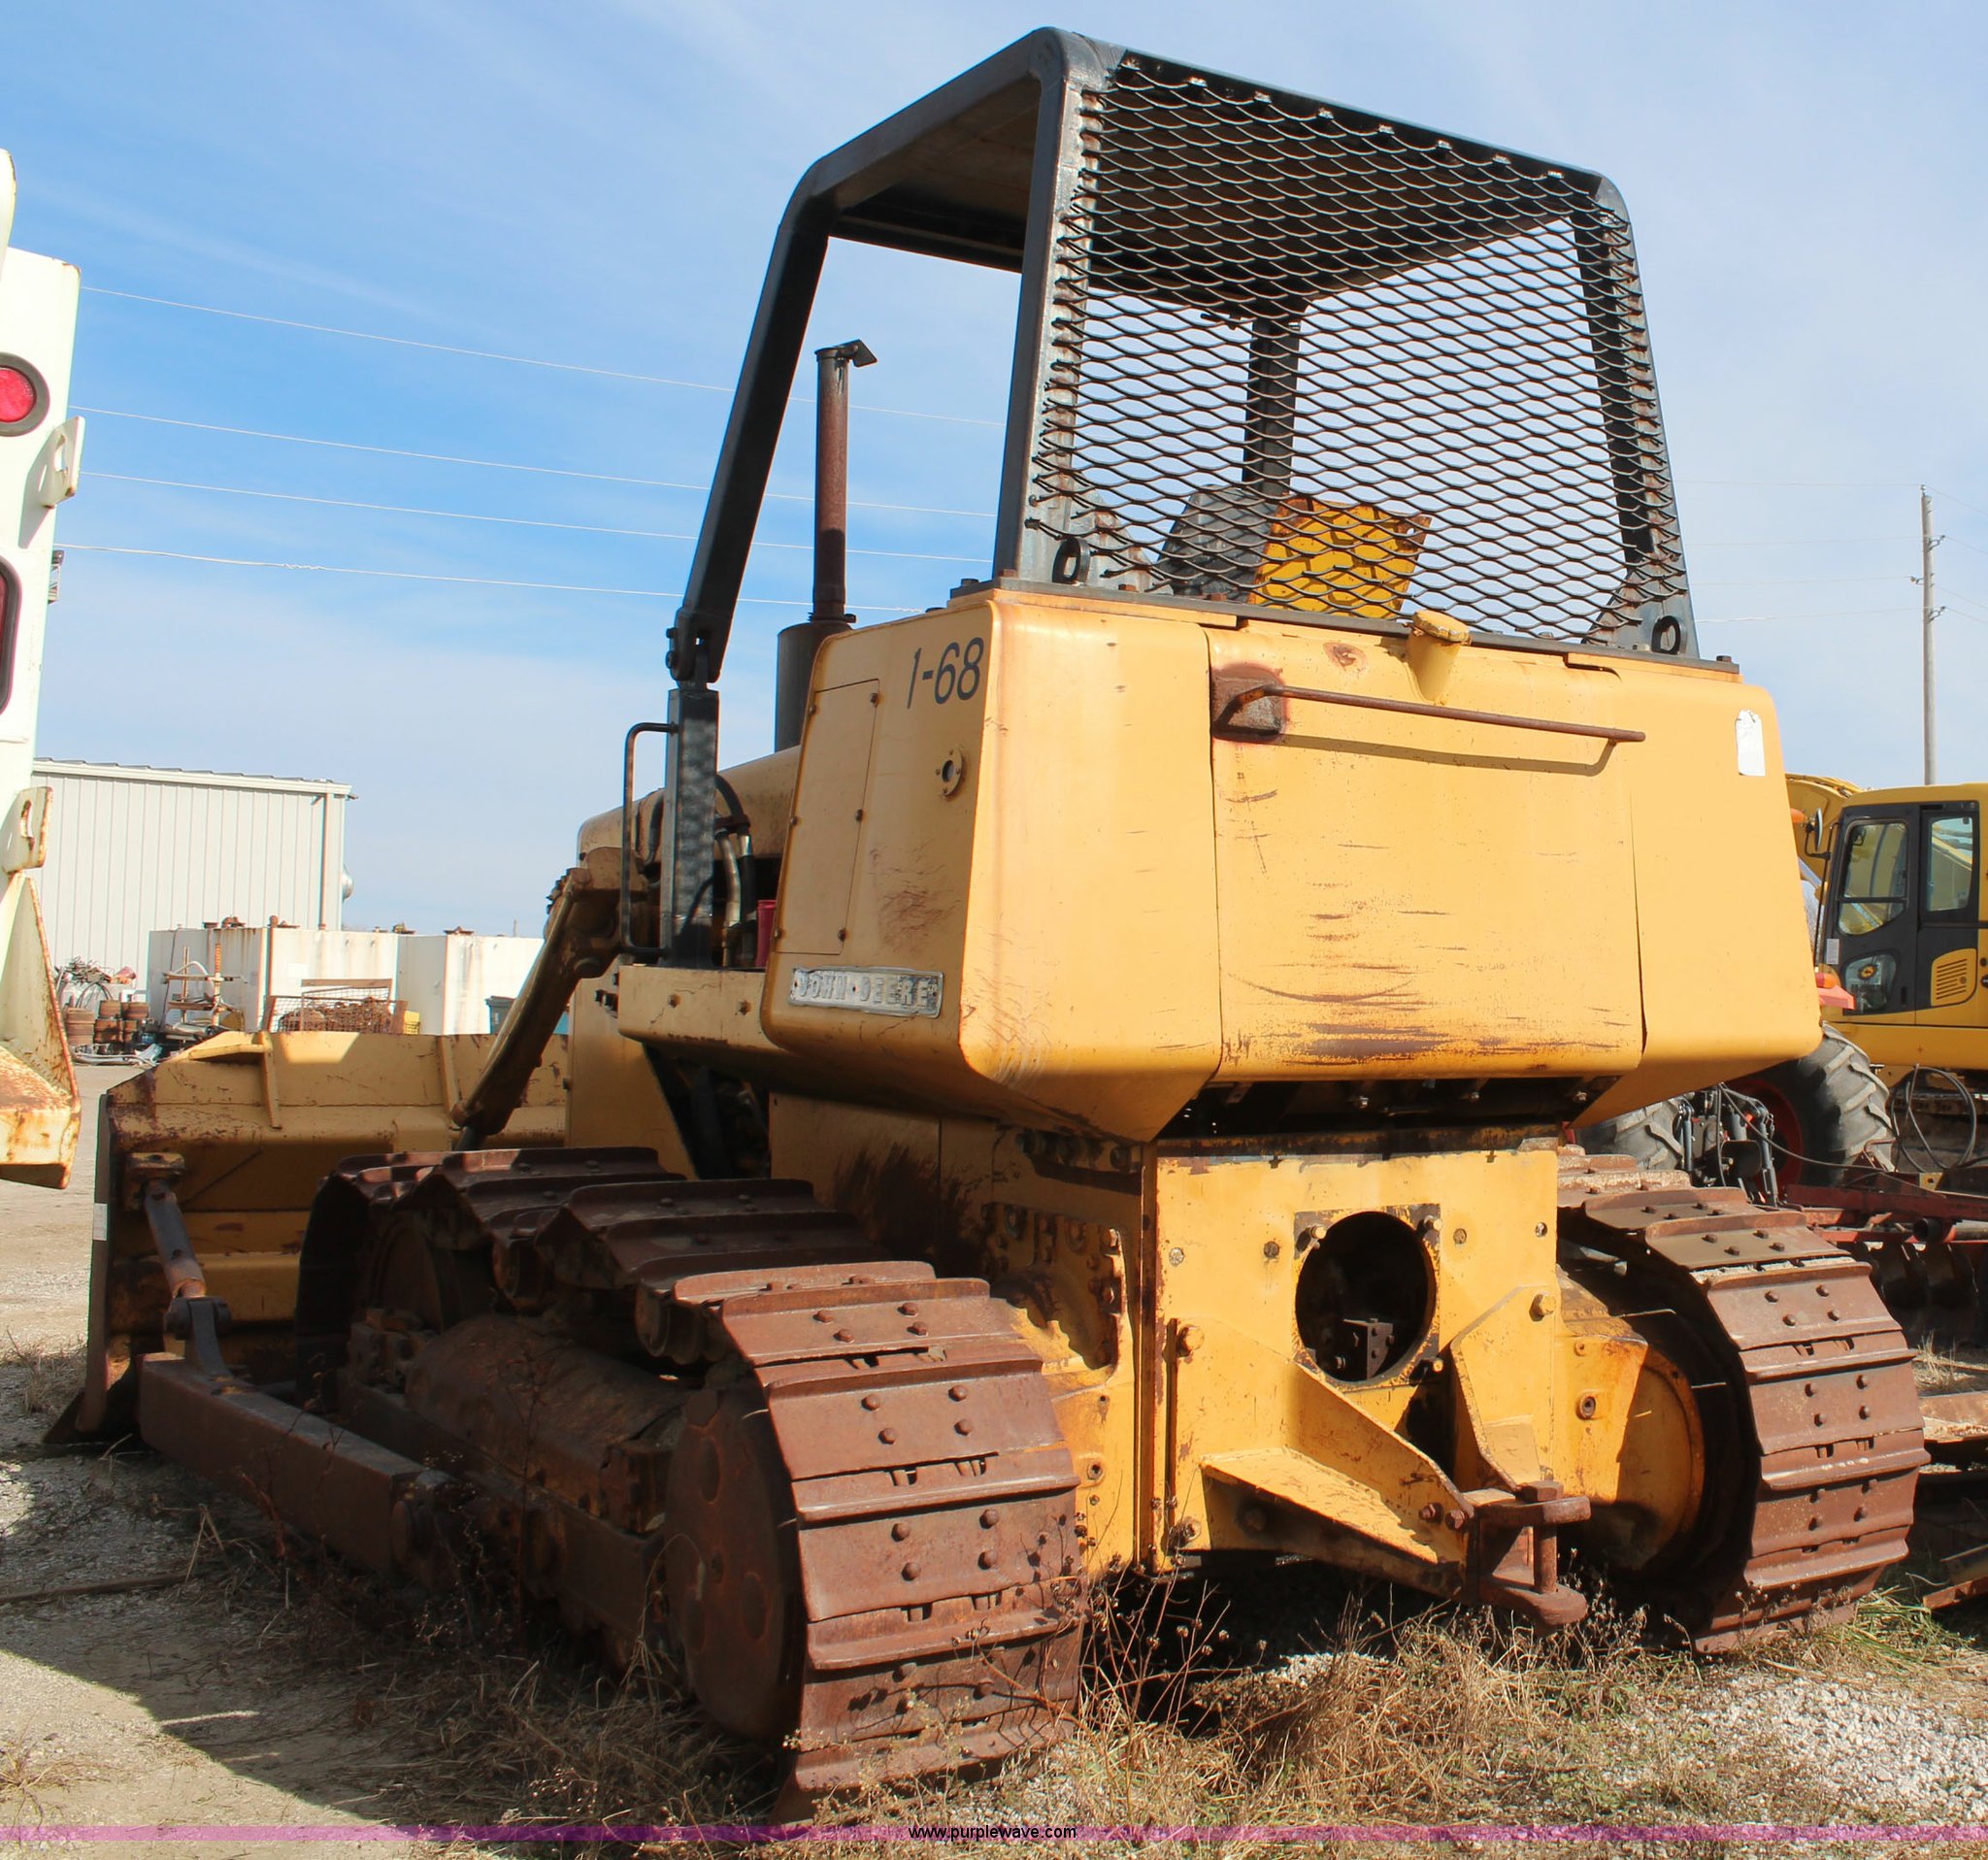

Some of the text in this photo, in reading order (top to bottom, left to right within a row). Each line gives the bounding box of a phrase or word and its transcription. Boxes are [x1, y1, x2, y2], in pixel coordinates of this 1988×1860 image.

[907, 637, 984, 710] 1-68
[797, 972, 930, 1010] JOHN DEERE
